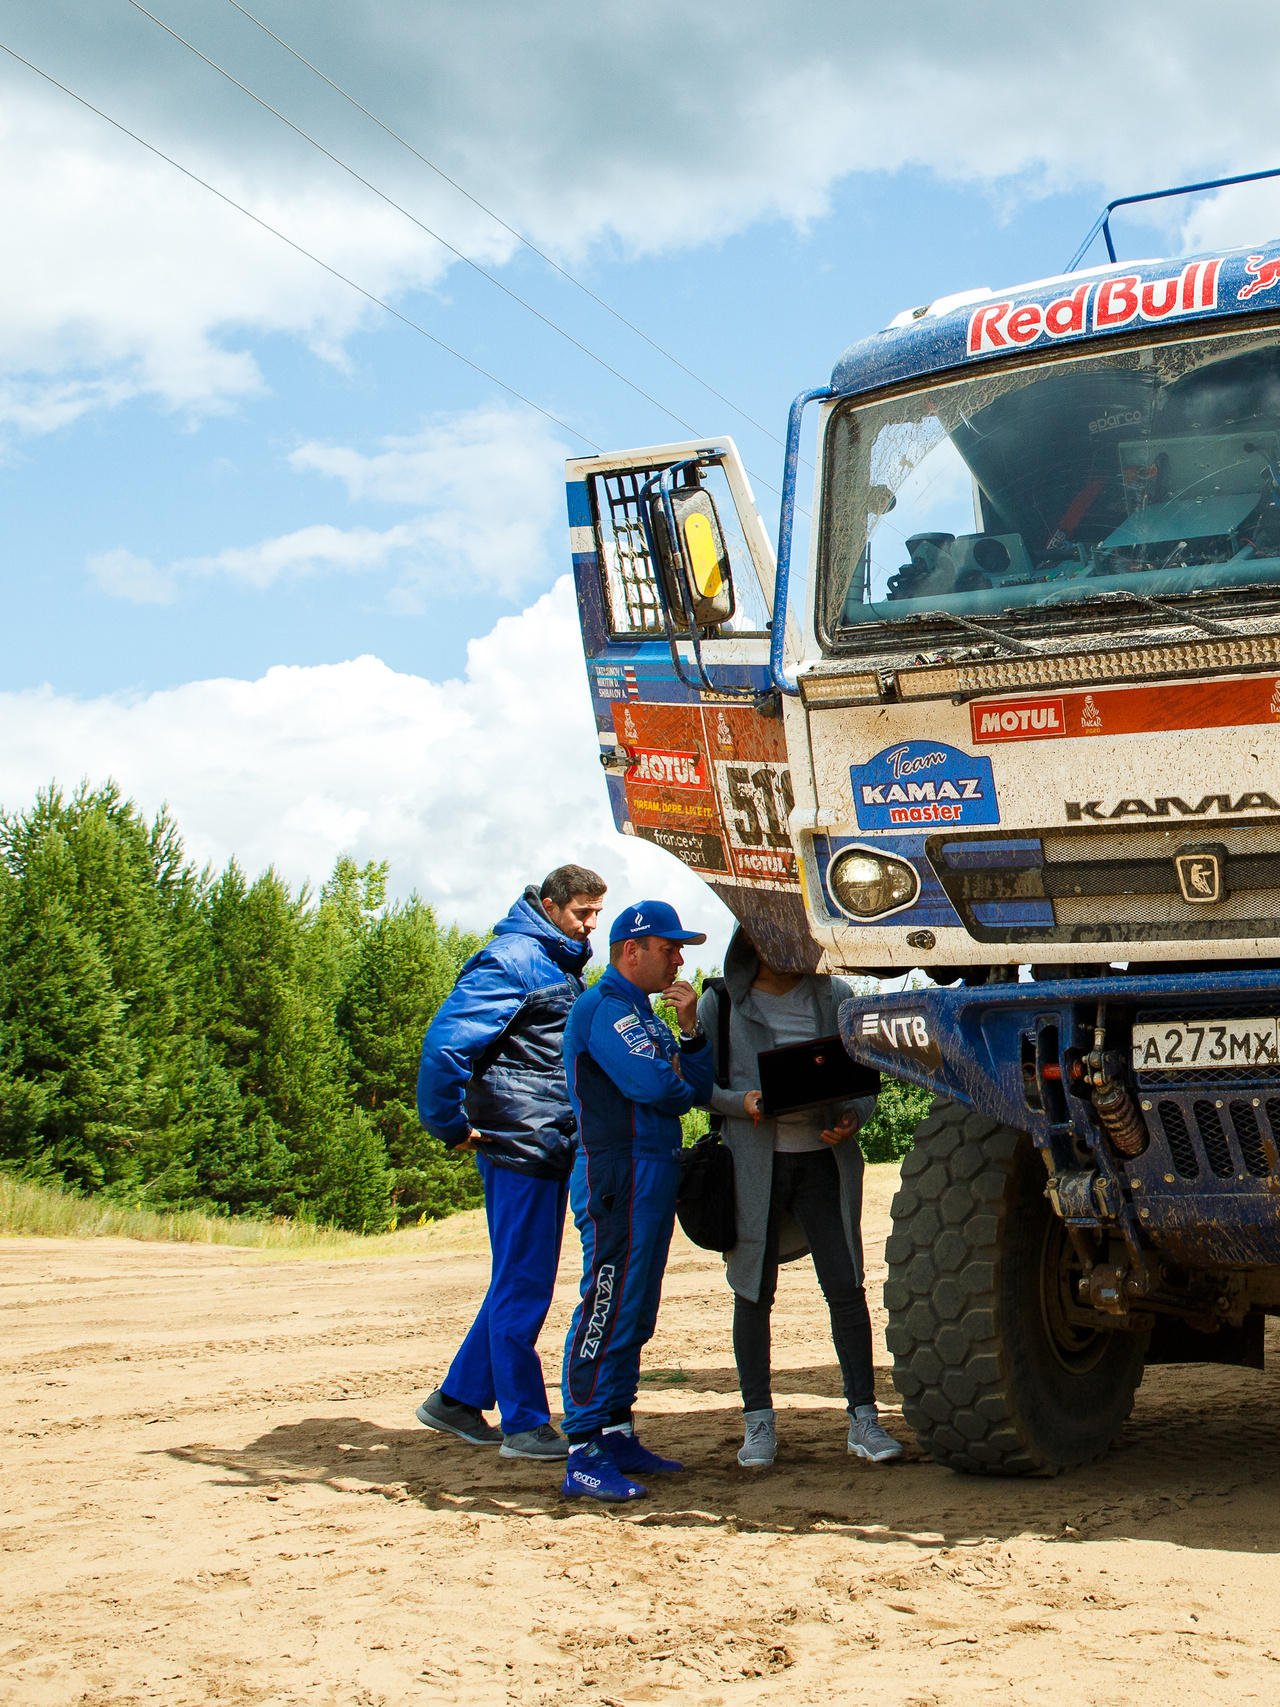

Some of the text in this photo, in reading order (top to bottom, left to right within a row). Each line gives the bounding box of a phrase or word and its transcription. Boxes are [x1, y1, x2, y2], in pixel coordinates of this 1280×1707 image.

[968, 258, 1225, 355] Red Bull
[1088, 409, 1142, 434] sparco
[980, 707, 1060, 733] MOTUL
[1081, 717, 1103, 728] DAKAR
[633, 753, 700, 784] MOTUL
[887, 746, 946, 779] Team
[861, 778, 982, 805] KAMAZ
[890, 804, 962, 823] master
[679, 849, 708, 866] sport
[880, 1015, 929, 1049] VTB
[580, 1264, 615, 1360] KAMAZ
[573, 1470, 602, 1487] sparco
